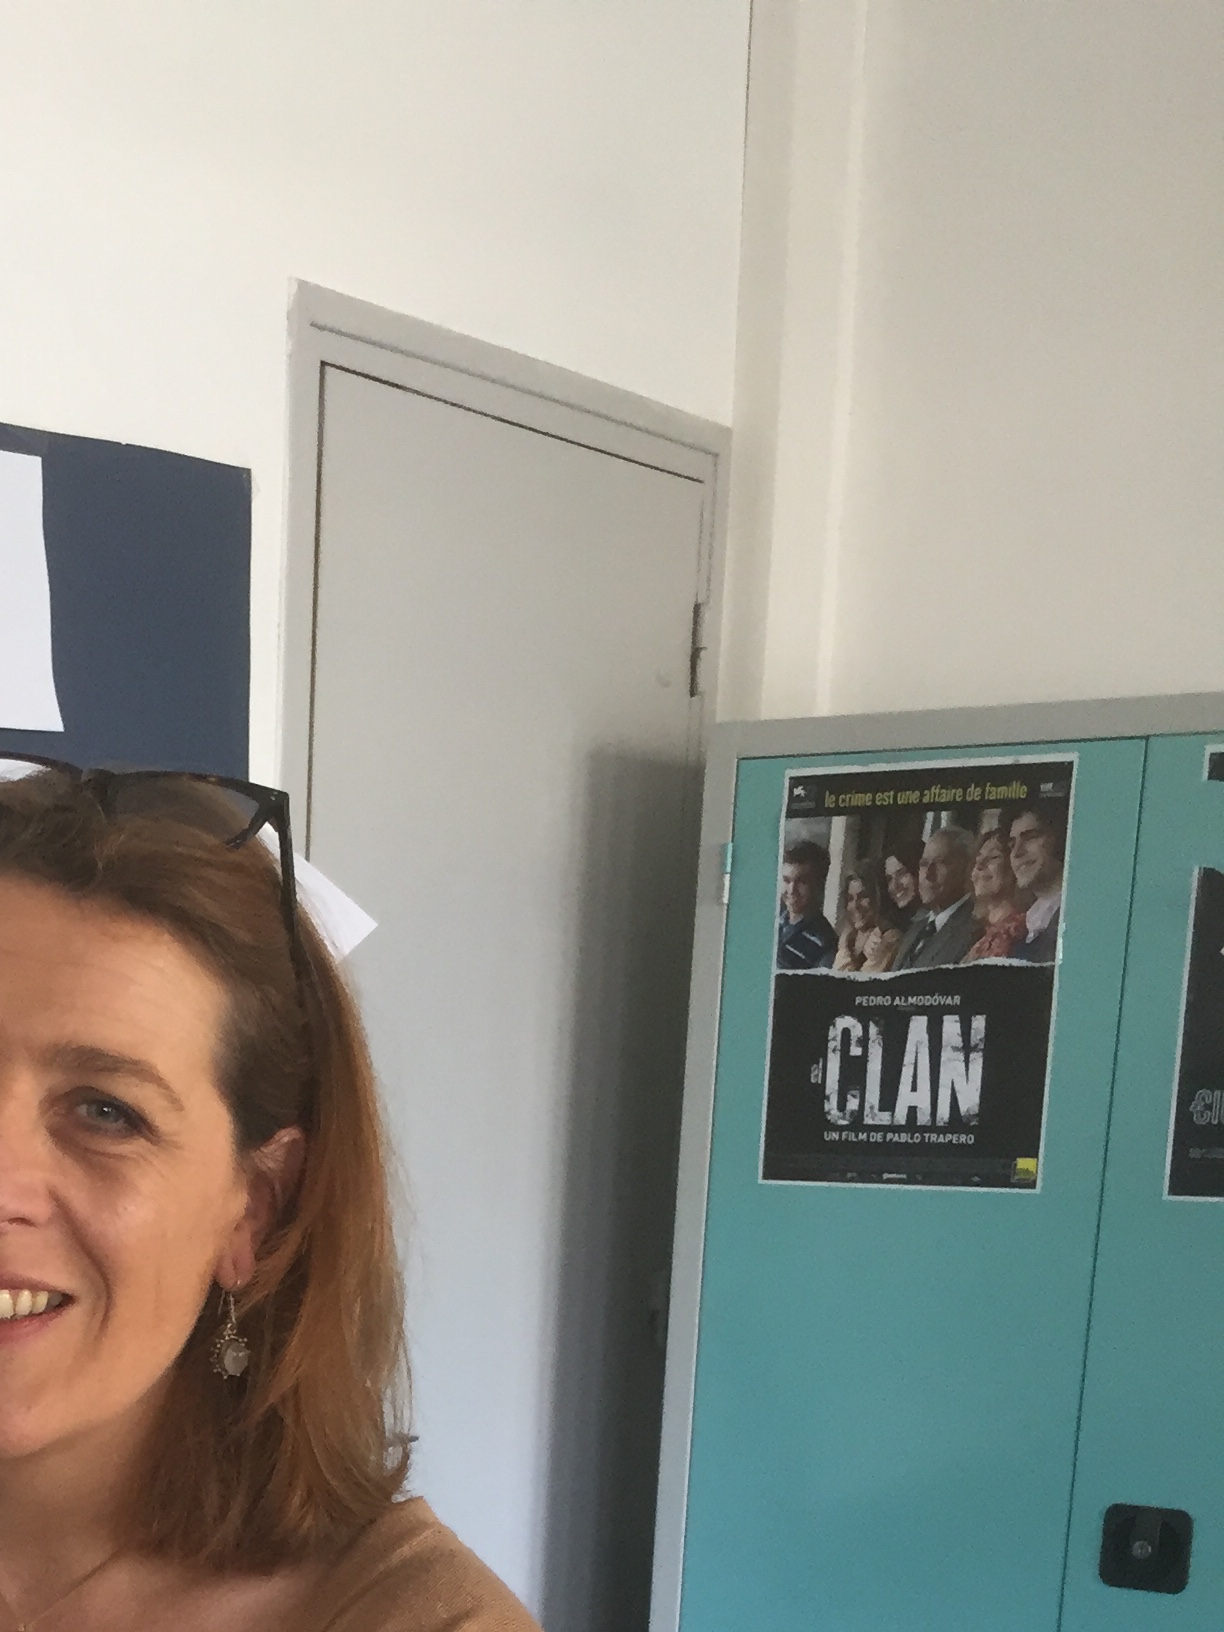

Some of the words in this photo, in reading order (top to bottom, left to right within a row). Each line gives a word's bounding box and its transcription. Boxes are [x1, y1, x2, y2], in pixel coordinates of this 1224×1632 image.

[824, 790, 836, 808] le
[838, 789, 873, 808] crime
[875, 788, 895, 806] est
[897, 790, 920, 805] une
[922, 784, 963, 804] affaire
[965, 783, 982, 802] de
[984, 780, 1028, 801] famille
[855, 995, 892, 1006] PEDRO
[893, 992, 961, 1006] ALMODÓVAR
[824, 1014, 987, 1127] CLAN
[823, 1131, 839, 1142] UN
[841, 1131, 868, 1142] FILM
[869, 1131, 884, 1142] DE
[885, 1131, 921, 1143] PABLO
[923, 1132, 975, 1145] TRAPERO
